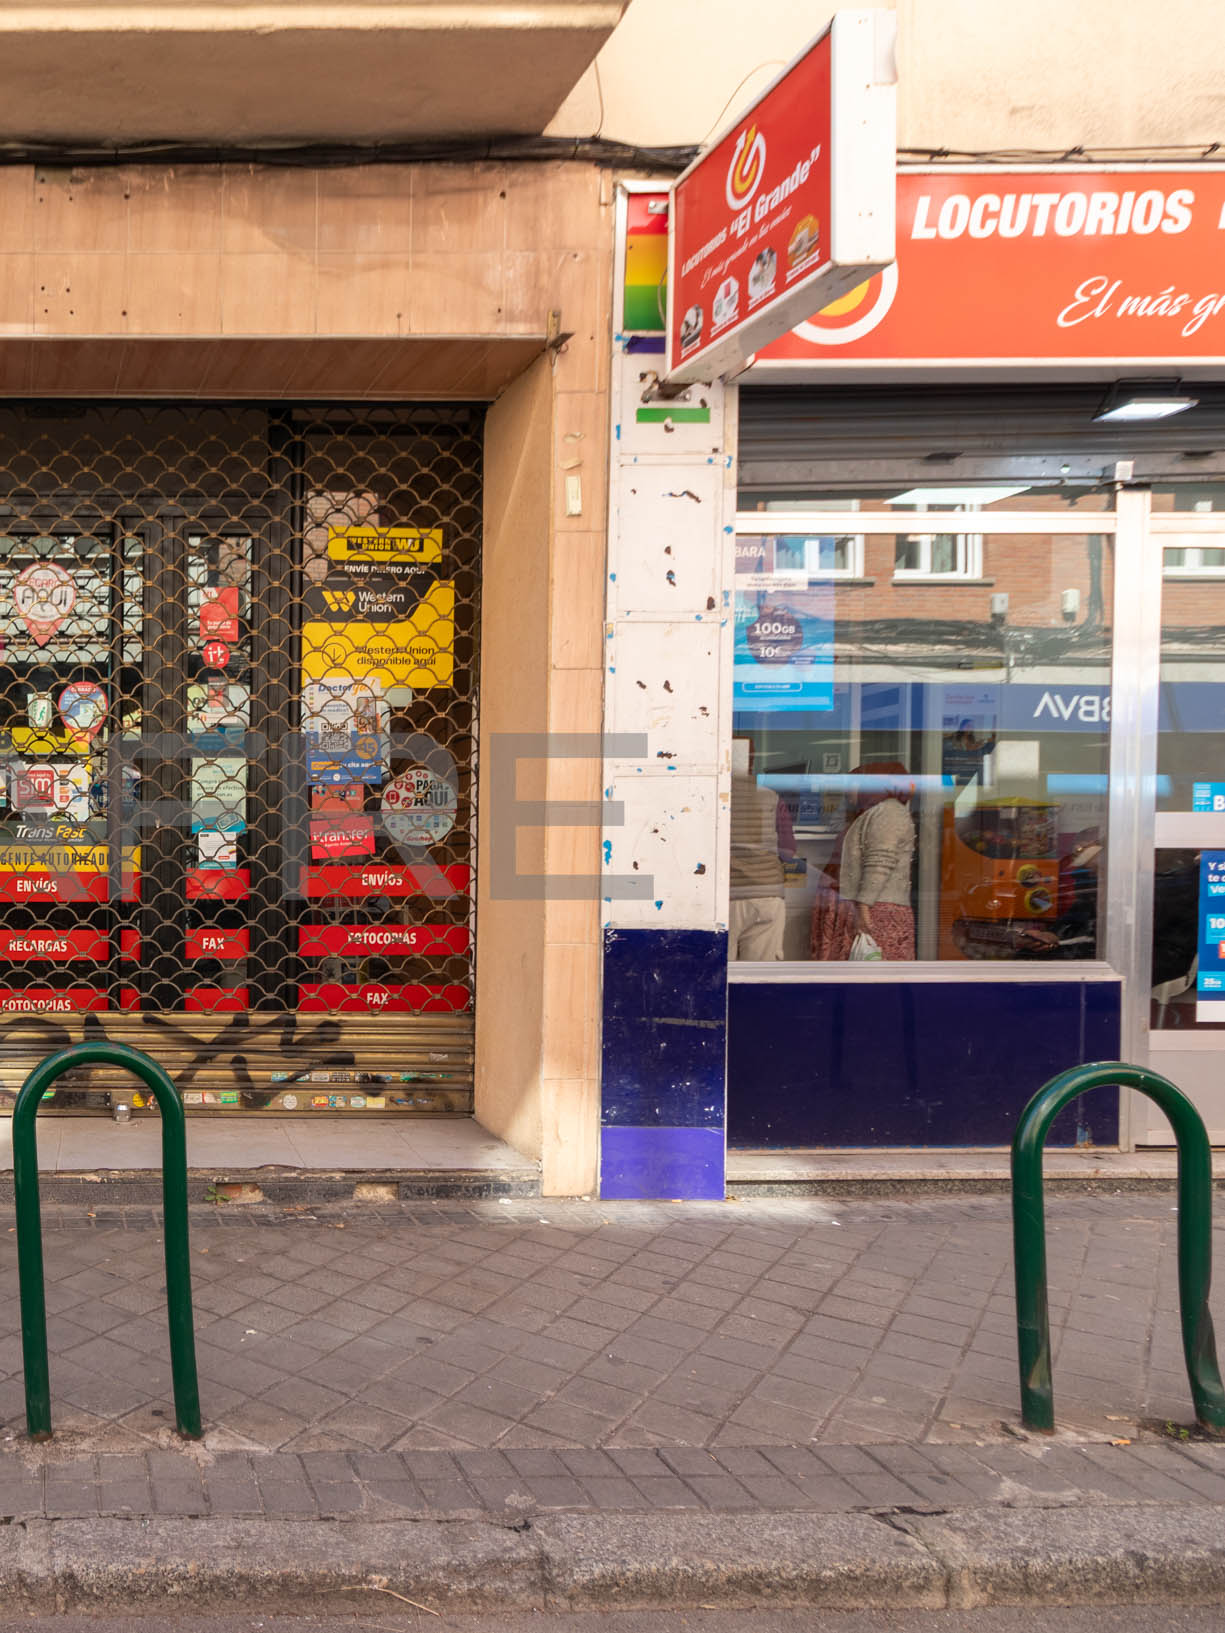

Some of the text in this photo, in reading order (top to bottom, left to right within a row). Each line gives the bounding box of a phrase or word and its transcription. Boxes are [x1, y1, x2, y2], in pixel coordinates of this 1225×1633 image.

[910, 189, 1195, 240] LOCUTORIOS
[1057, 275, 1123, 328] El
[1117, 285, 1193, 318] más
[358, 591, 405, 604] Western
[358, 603, 392, 613] Union
[754, 622, 796, 635] 100GB
[357, 646, 435, 655] Western Union
[356, 656, 412, 667] disponible
[16, 824, 87, 838] Trans Fast
[361, 870, 403, 886] ENVÍOS
[16, 877, 58, 893] ENVÍOS
[8, 939, 68, 952] RECARGAS
[202, 937, 225, 950] FAX
[1, 999, 72, 1011] FOTOCOPIAS
[366, 992, 389, 1005] FAX
